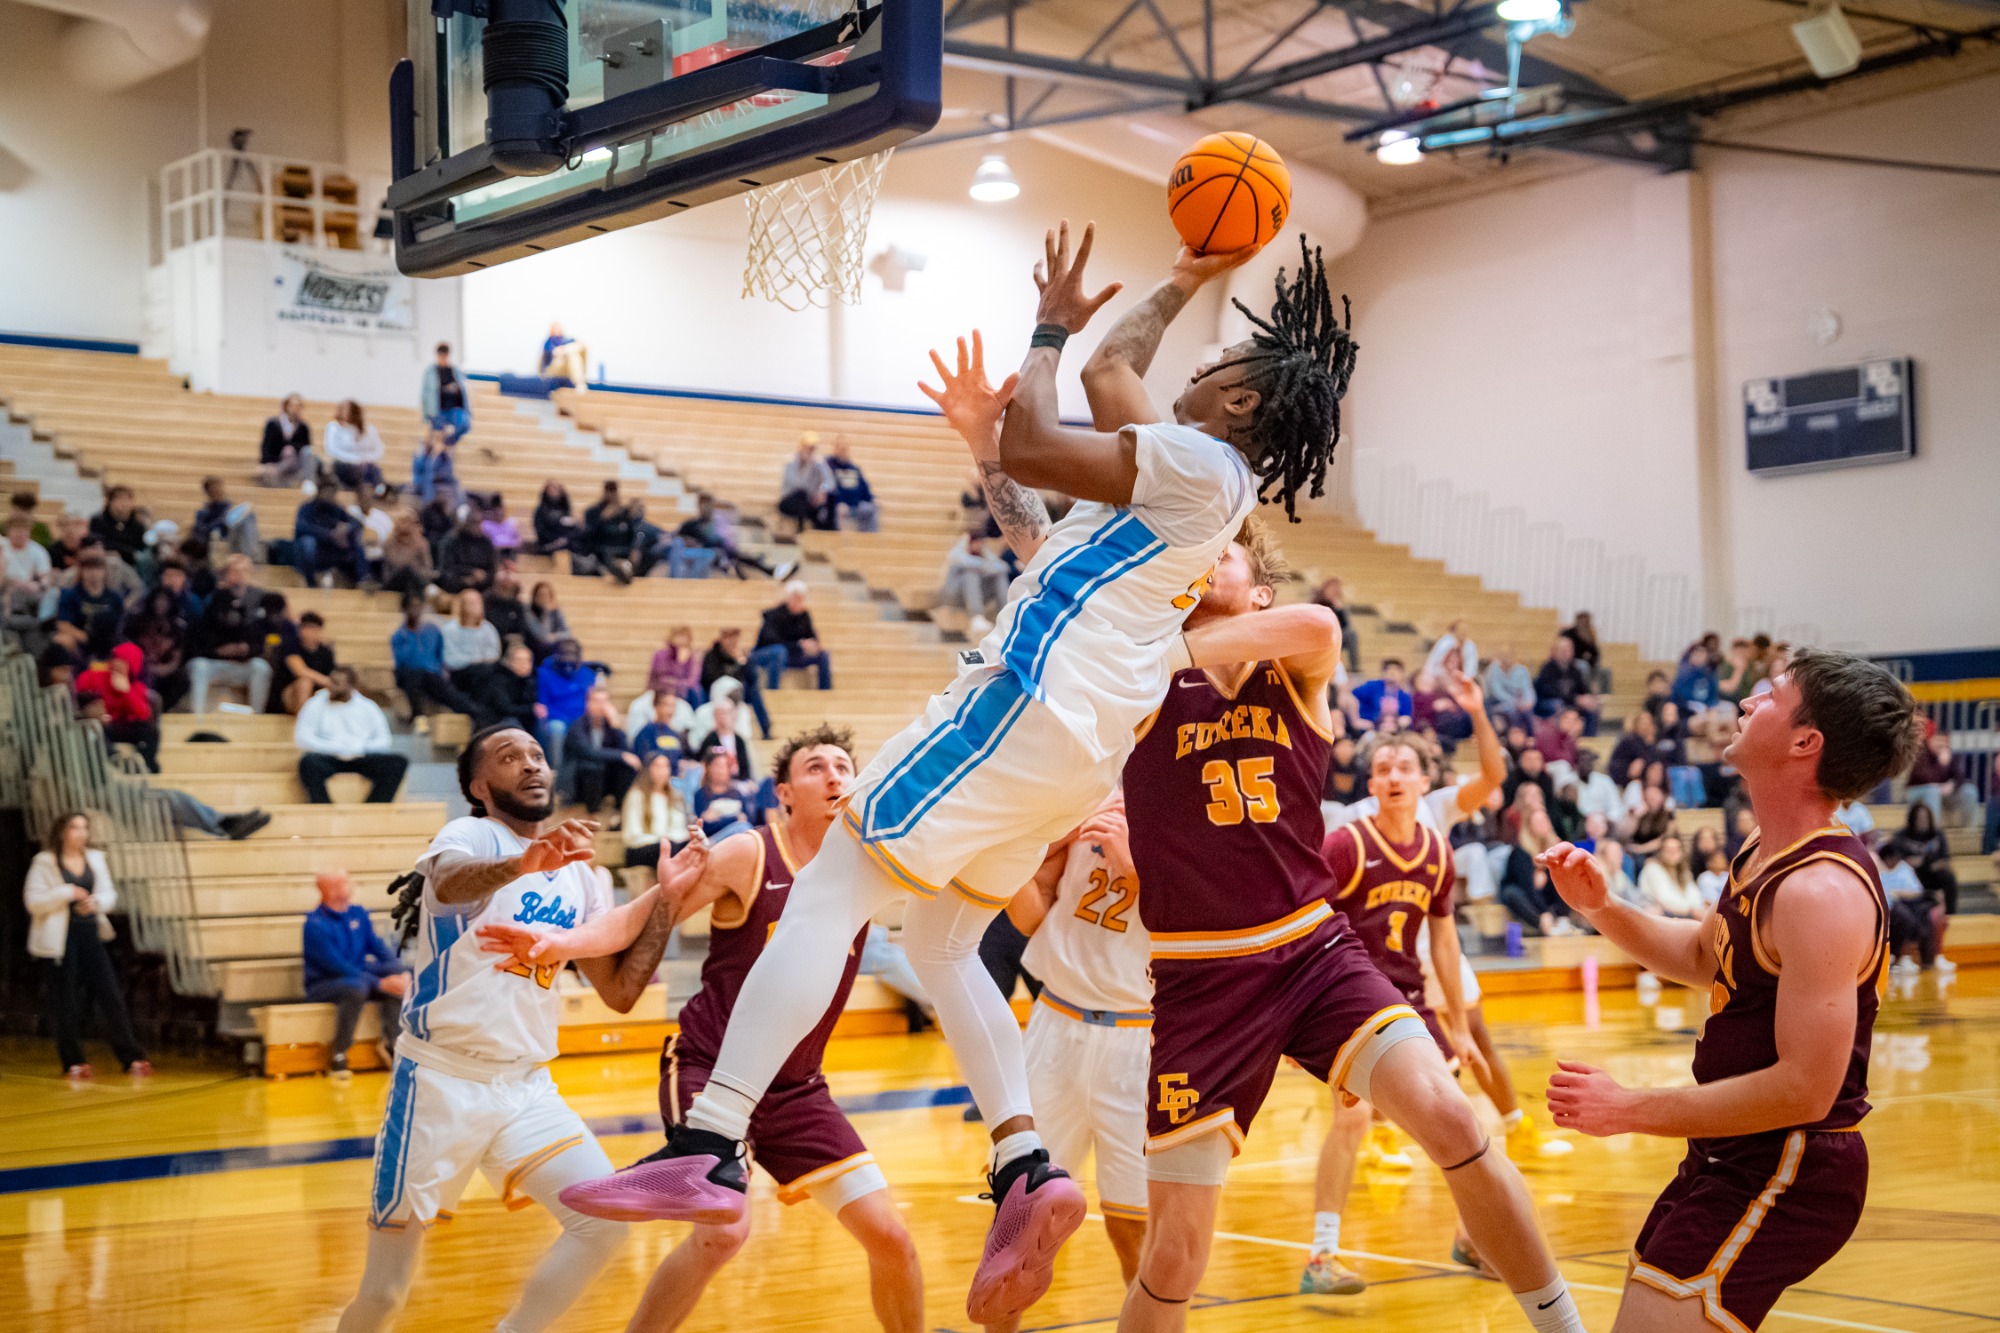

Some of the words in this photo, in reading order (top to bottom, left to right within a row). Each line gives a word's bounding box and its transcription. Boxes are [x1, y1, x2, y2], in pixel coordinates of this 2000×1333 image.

[1175, 705, 1293, 760] EUREKA
[1202, 756, 1281, 826] 35
[1074, 867, 1137, 933] 22
[1157, 1072, 1200, 1124] EC
